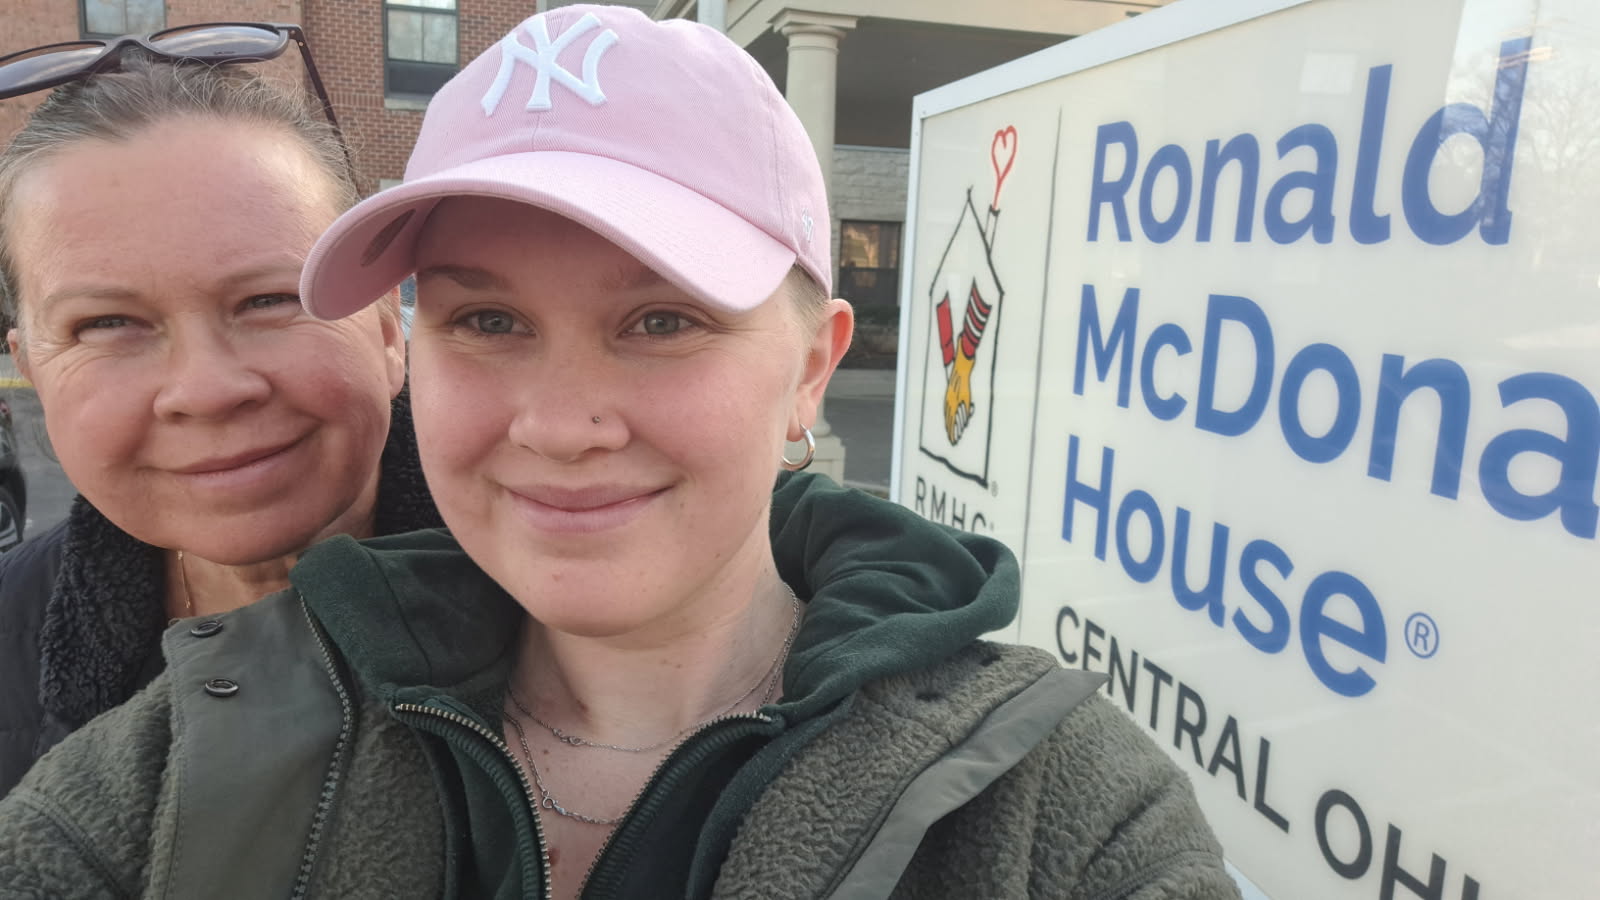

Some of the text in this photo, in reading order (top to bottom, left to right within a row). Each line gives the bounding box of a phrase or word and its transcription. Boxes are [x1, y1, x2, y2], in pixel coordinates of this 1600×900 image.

[480, 12, 620, 118] NY
[1087, 37, 1533, 246] Ronald
[1063, 284, 1600, 540] McDona
[1062, 435, 1388, 698] House
[1056, 604, 1481, 900] CENTRAL OH
